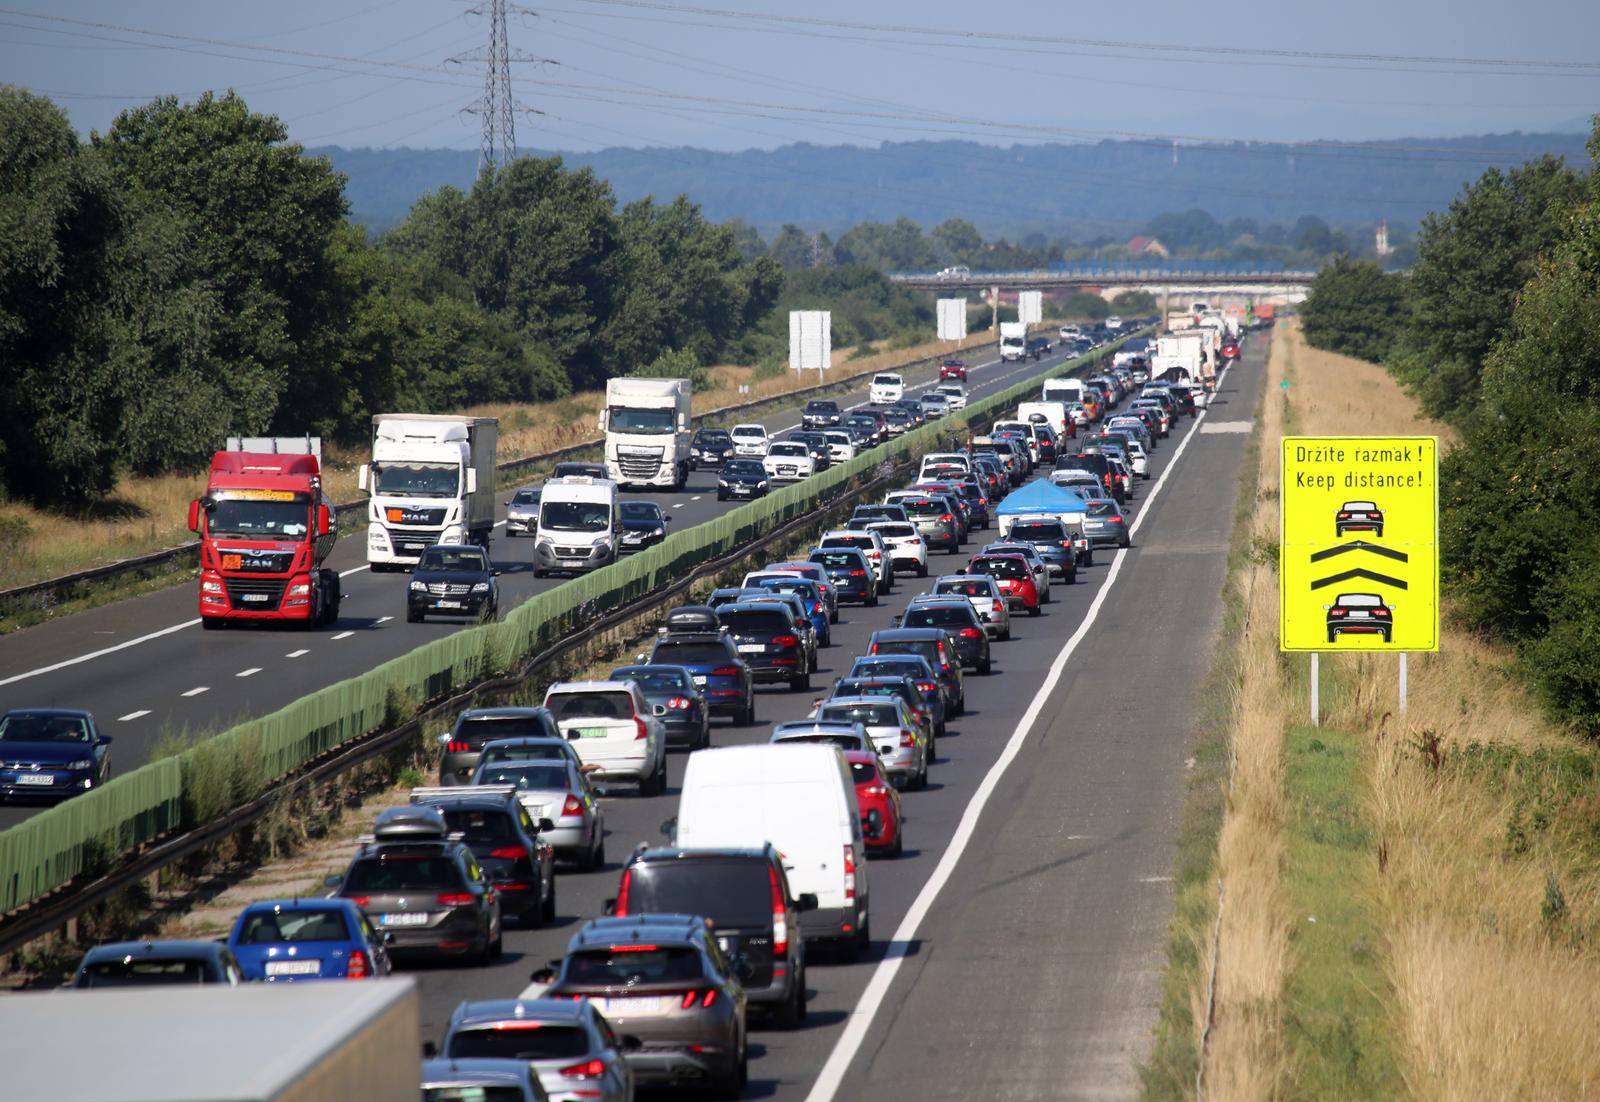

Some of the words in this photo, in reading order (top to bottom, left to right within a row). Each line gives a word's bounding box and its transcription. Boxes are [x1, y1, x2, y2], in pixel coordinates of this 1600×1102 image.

[1296, 445, 1345, 462] Držite
[1296, 471, 1335, 491] Keep
[401, 513, 429, 521] MAN
